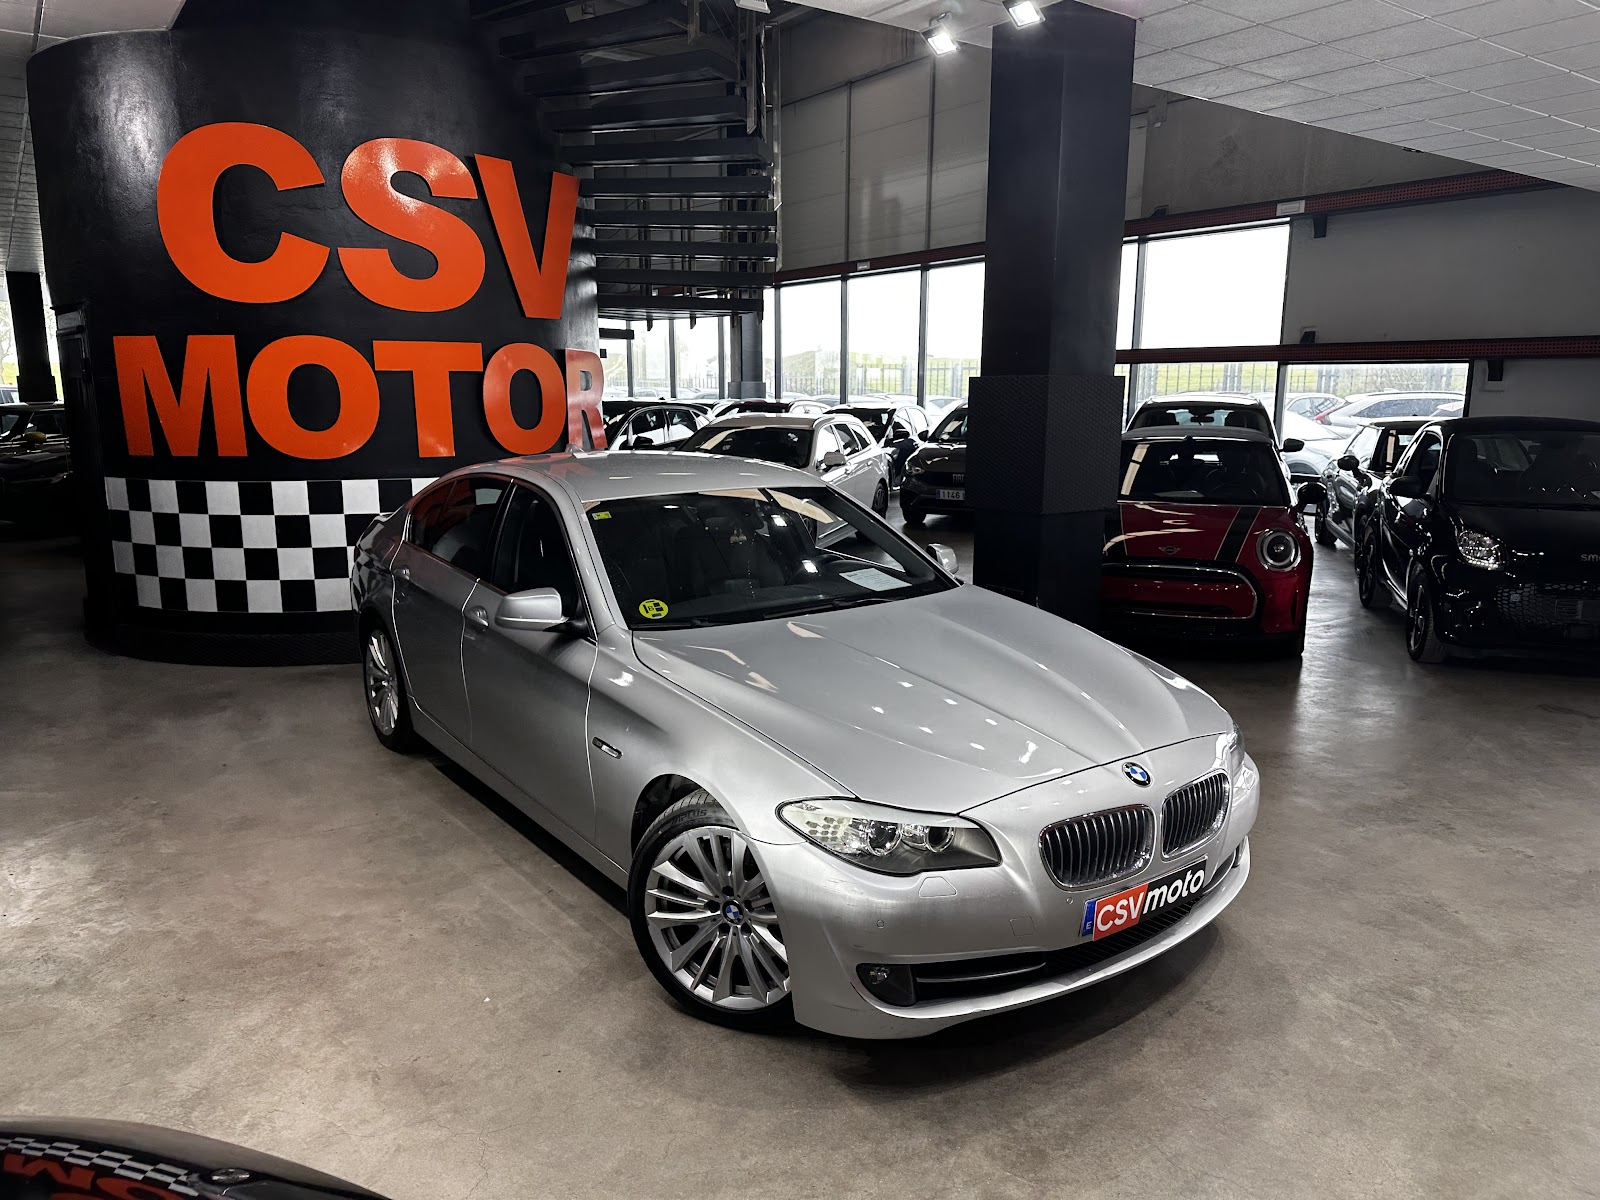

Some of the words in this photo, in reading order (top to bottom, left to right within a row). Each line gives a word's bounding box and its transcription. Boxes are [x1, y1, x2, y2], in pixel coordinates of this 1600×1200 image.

[156, 121, 580, 320] CSV
[113, 334, 608, 460] MOTOR
[952, 473, 964, 483] FIAT
[1580, 553, 1600, 562] sm
